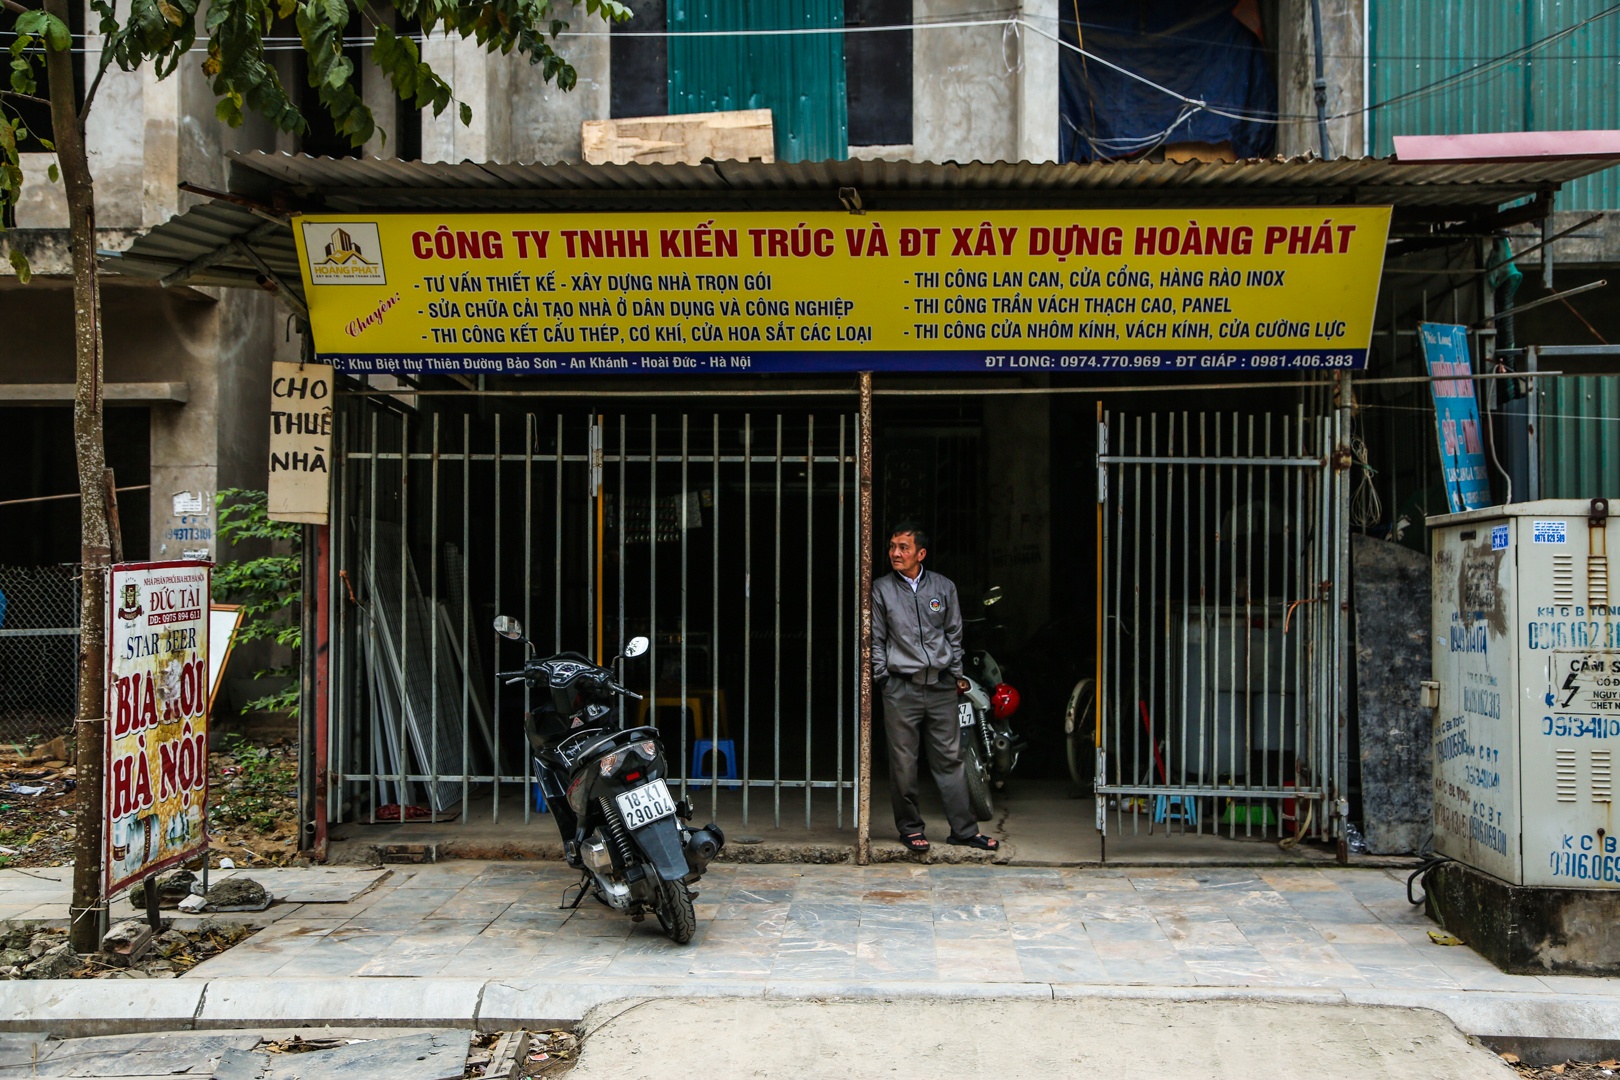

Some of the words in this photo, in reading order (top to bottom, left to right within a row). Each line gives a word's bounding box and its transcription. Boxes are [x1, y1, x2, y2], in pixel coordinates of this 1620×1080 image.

[411, 224, 504, 260] CÔNG
[511, 230, 550, 259] TY
[560, 229, 649, 259] TNHH
[659, 219, 738, 258] KIẾN
[748, 222, 835, 258] TRÚC
[845, 222, 889, 257] VÀ
[898, 228, 941, 257] ĐT
[950, 221, 1019, 257] XÂY
[1028, 224, 1123, 263] DỰNG
[1134, 220, 1254, 256] HOÀNG
[1263, 219, 1357, 255] PHÁT
[423, 274, 445, 293] TƯ
[448, 270, 482, 293] VẤN
[485, 270, 531, 292] THIẾT
[535, 270, 556, 292] KẾ
[570, 271, 603, 292] XÂY
[607, 273, 653, 295] DỰNG
[657, 271, 692, 291] NHÀ
[695, 274, 739, 294] TRỌN
[744, 270, 772, 291] GÓI
[914, 272, 939, 288] THI
[944, 268, 988, 288] CÔNG
[992, 271, 1023, 288] LAN
[1028, 271, 1064, 290] CAN,
[1069, 266, 1101, 288] CỬA
[1106, 264, 1154, 290] CỔNG,
[1159, 267, 1204, 288] HÀNG
[1208, 267, 1242, 287] RÀO
[1246, 270, 1286, 287] INOX
[345, 290, 400, 339] Chuyên:
[428, 297, 462, 319] SỬA
[464, 299, 509, 318] CHỮA
[512, 297, 539, 318] CẢI
[542, 301, 574, 321] TẠO
[578, 297, 613, 317] NHÀ
[616, 296, 628, 317] Ở
[632, 297, 665, 317] DÂN
[670, 300, 715, 320] DỤNG
[719, 297, 741, 317] VÀ
[745, 297, 790, 317] CÔNG
[795, 297, 854, 320] NGHIỆP
[913, 298, 939, 314] THI
[944, 294, 987, 314] CÔNG
[991, 292, 1033, 314] TRẦN
[1037, 293, 1079, 314] VÁCH
[1084, 297, 1136, 317] THẠCH
[1141, 297, 1176, 316] CAO,
[1182, 297, 1232, 313] PANEL
[430, 328, 458, 343] THI
[461, 324, 506, 343] CÔNG
[509, 322, 539, 343] KẾT
[543, 321, 575, 343] CẤU
[578, 323, 625, 344] THÉP,
[629, 324, 650, 342] CƠ
[655, 322, 687, 344] KHÍ,
[691, 321, 724, 342] CỬA
[728, 326, 761, 342] HOA
[765, 320, 796, 342] SẮT
[800, 322, 831, 342] CÁC
[836, 325, 872, 345] LOẠI
[913, 323, 939, 339] THI
[943, 320, 986, 339] CÔNG
[991, 318, 1022, 339] CỬA
[1027, 319, 1074, 339] NHÔM
[1078, 319, 1120, 341] KÍNH,
[1125, 319, 1167, 339] VÁCH
[1171, 319, 1213, 341] KÍNH,
[1218, 318, 1250, 339] CỬA
[1255, 318, 1311, 338] CƯỜNG
[1314, 319, 1346, 341] LỰC
[348, 358, 372, 370] Khu
[375, 358, 400, 372] Biệt
[402, 358, 423, 372] thự
[425, 357, 460, 370] Thiên
[462, 357, 503, 372] Đường
[506, 356, 530, 369] Bảo
[533, 357, 557, 369] Sơn
[570, 357, 586, 369] An
[589, 356, 629, 368] Khánh
[641, 356, 669, 368] Hoài
[672, 356, 697, 368] Đức
[709, 356, 727, 368] Hà
[730, 356, 751, 370] Nội
[984, 356, 1006, 368] ĐT
[1009, 355, 1055, 368] LONG:
[1060, 355, 1161, 368] 0974.770.969
[1175, 355, 1197, 367] ĐT
[1200, 353, 1237, 367] GIÁP
[1250, 354, 1353, 367] 0981.406.383
[272, 377, 328, 400] CHO
[270, 406, 332, 435] THUÊ
[271, 446, 327, 473] NHÀ
[150, 585, 175, 612] ĐỨC
[179, 584, 200, 609] TÀI
[162, 613, 176, 623] 0975
[177, 612, 189, 621] 894
[189, 610, 200, 620] 611
[127, 632, 159, 660] STAR
[115, 669, 158, 736] BIA
[1593, 691, 1617, 699] NGUY
[113, 734, 154, 819] HÀ
[159, 721, 204, 807] NỘI
[624, 783, 662, 810] 18-K1
[626, 797, 673, 828] 290.04
